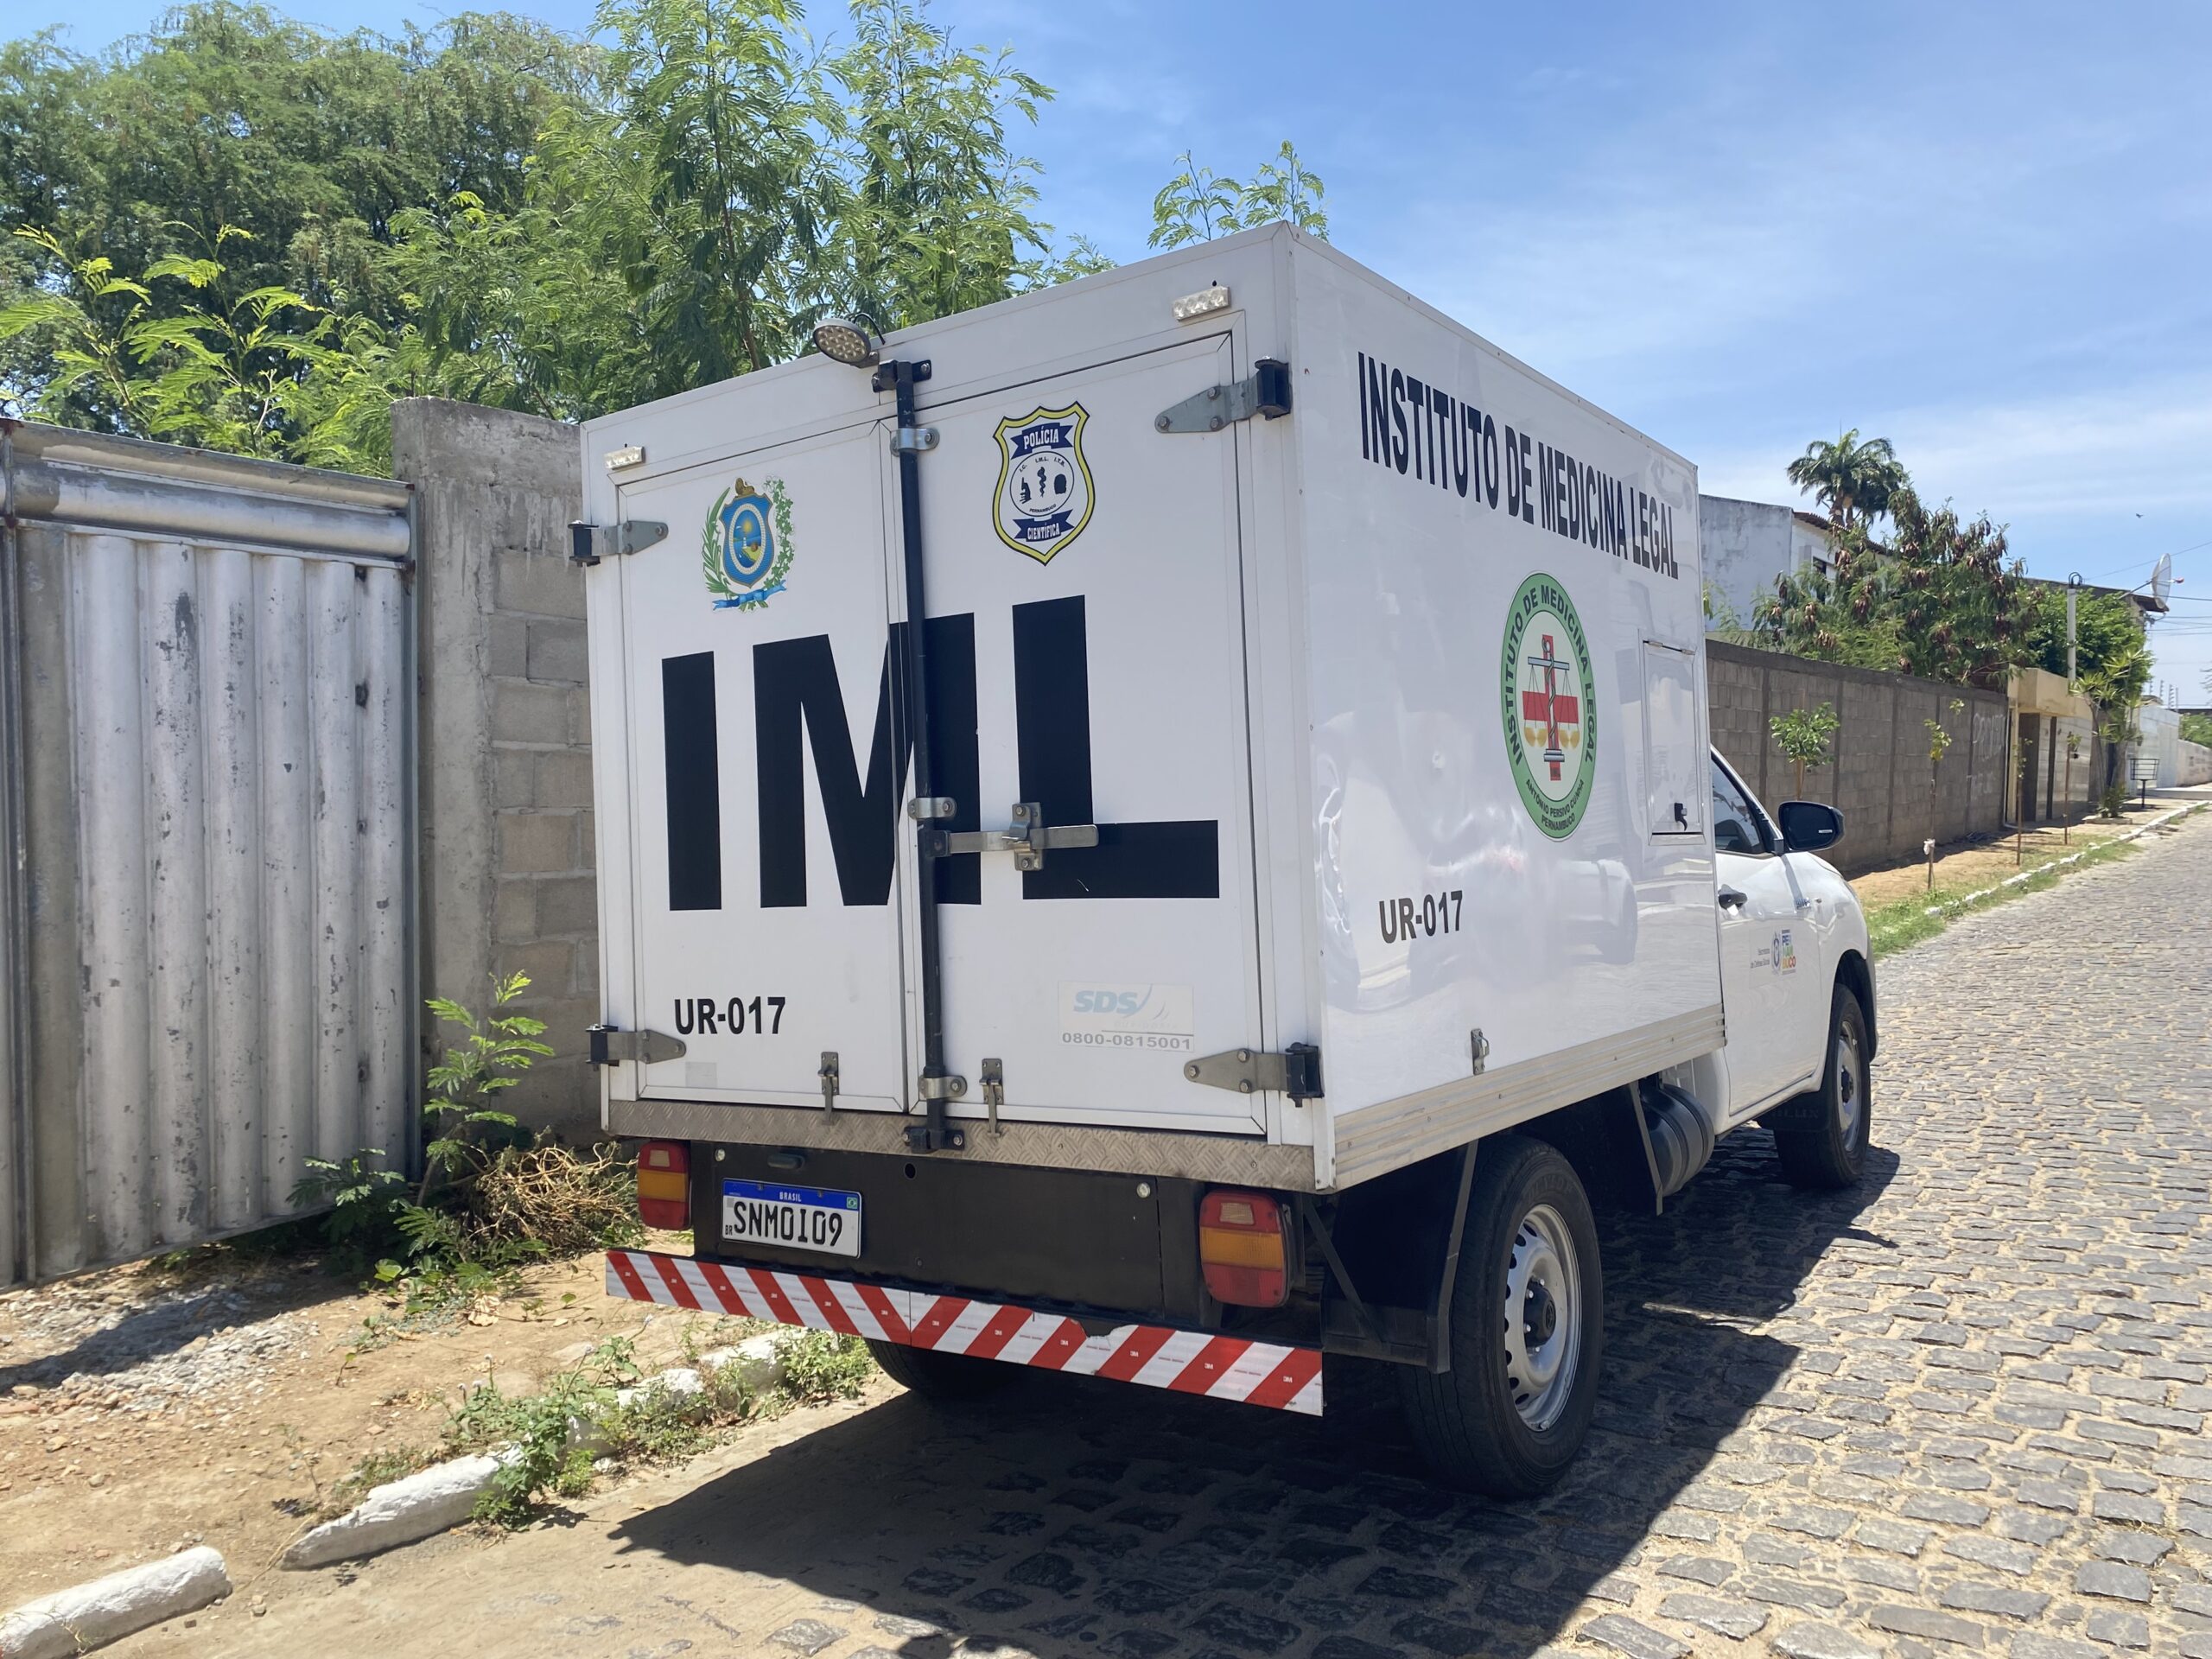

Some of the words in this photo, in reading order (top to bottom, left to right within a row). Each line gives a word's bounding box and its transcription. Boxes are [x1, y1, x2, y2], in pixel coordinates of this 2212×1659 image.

[1023, 426, 1059, 449] POLÍCIA
[1357, 351, 1499, 510] INSTITUTO
[1505, 424, 1535, 524] DE
[1538, 441, 1628, 560] MEDICINA
[1630, 486, 1679, 580] LEGAL
[1029, 503, 1057, 513] PERNAMBUCO
[1027, 522, 1060, 540] CIENTÍFICA
[1505, 612, 1523, 766] INSTITUTO
[1522, 588, 1538, 615] DE
[1541, 584, 1588, 674] MEDICINA
[1585, 683, 1595, 762] LEGAL
[662, 594, 1220, 912] IML
[1541, 812, 1575, 831] PERNAMBUCO
[1379, 890, 1463, 944] UR-017
[1072, 989, 1141, 1017] SDS
[674, 996, 785, 1035] UR-017
[1062, 1032, 1191, 1051] 0800-0815001
[779, 1191, 802, 1203] BRASIL
[725, 1224, 733, 1236] BR
